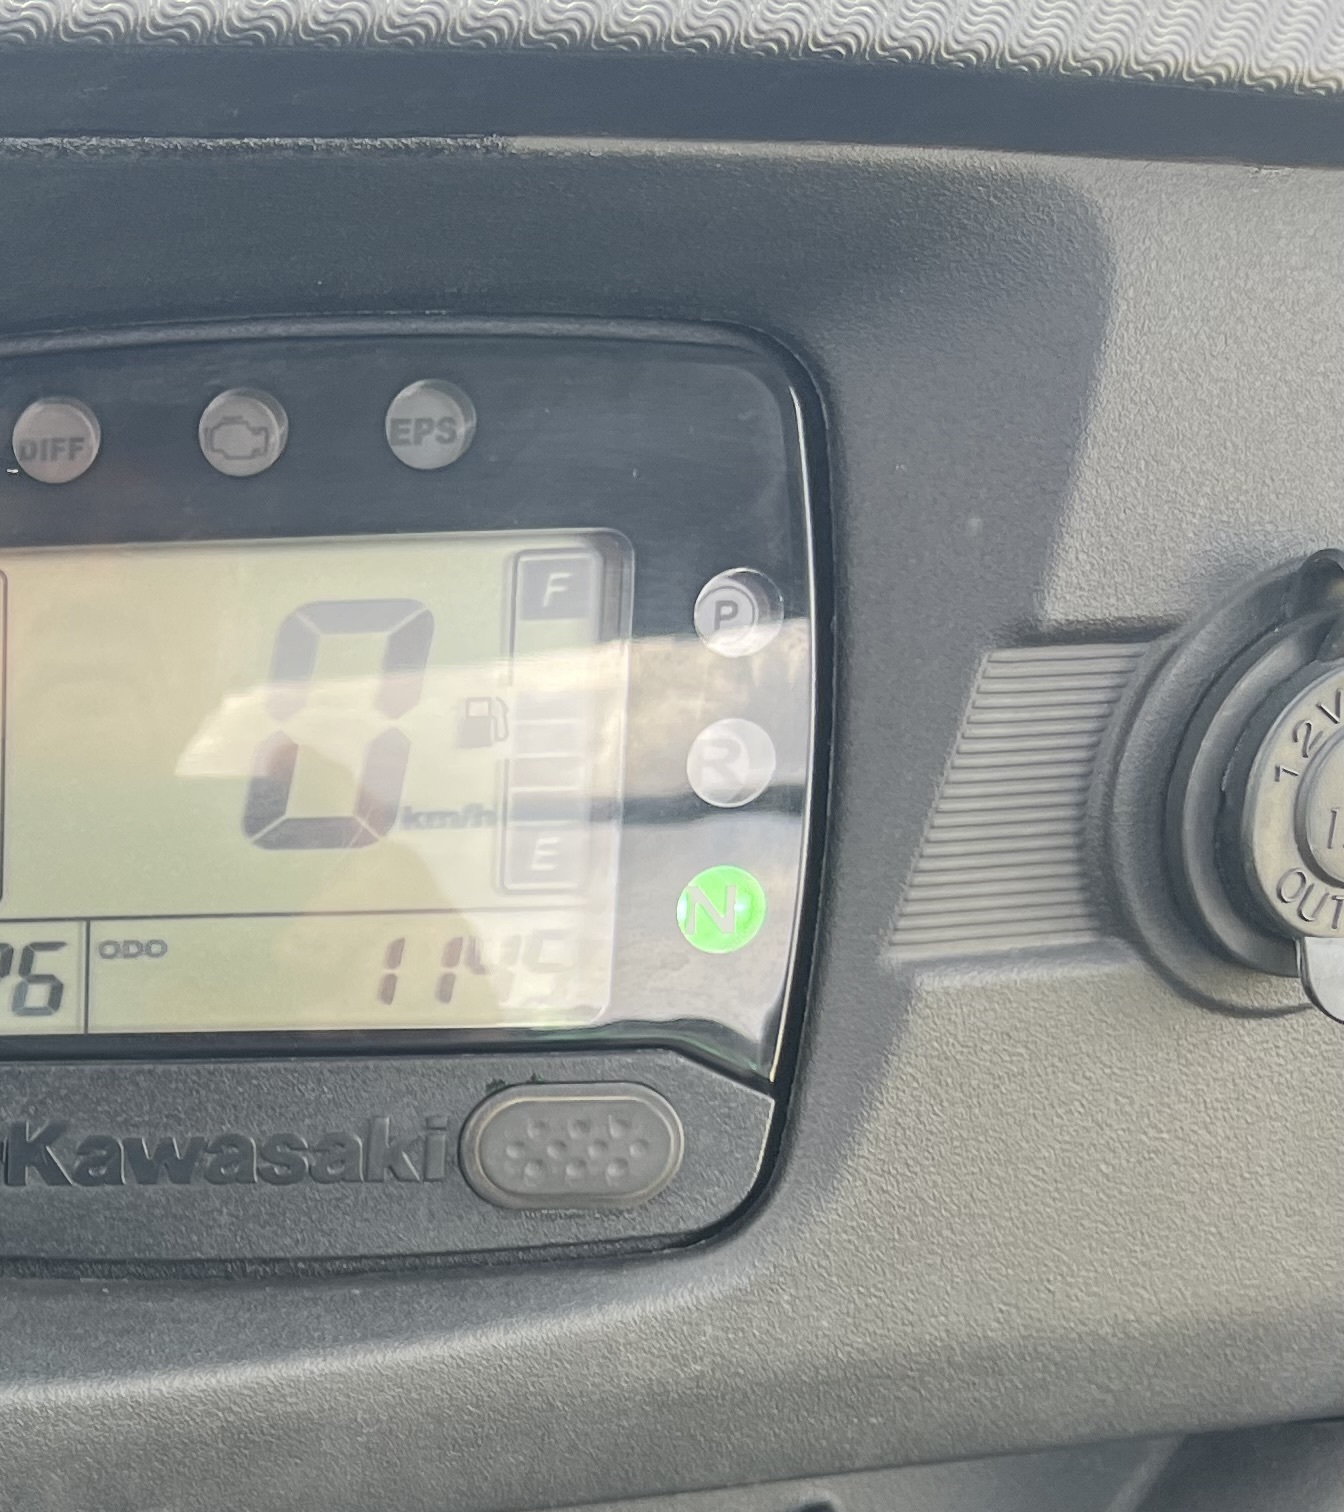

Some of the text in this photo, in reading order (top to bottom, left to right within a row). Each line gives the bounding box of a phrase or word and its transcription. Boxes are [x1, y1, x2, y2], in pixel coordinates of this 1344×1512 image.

[18, 436, 85, 462] DIFF
[389, 415, 458, 447] EPS
[542, 572, 573, 608] F
[241, 597, 436, 851] 0
[698, 738, 744, 788] R
[531, 836, 561, 871] E
[685, 884, 737, 935] N
[97, 938, 169, 960] ODO
[3, 1115, 450, 1188] Kawasaki
